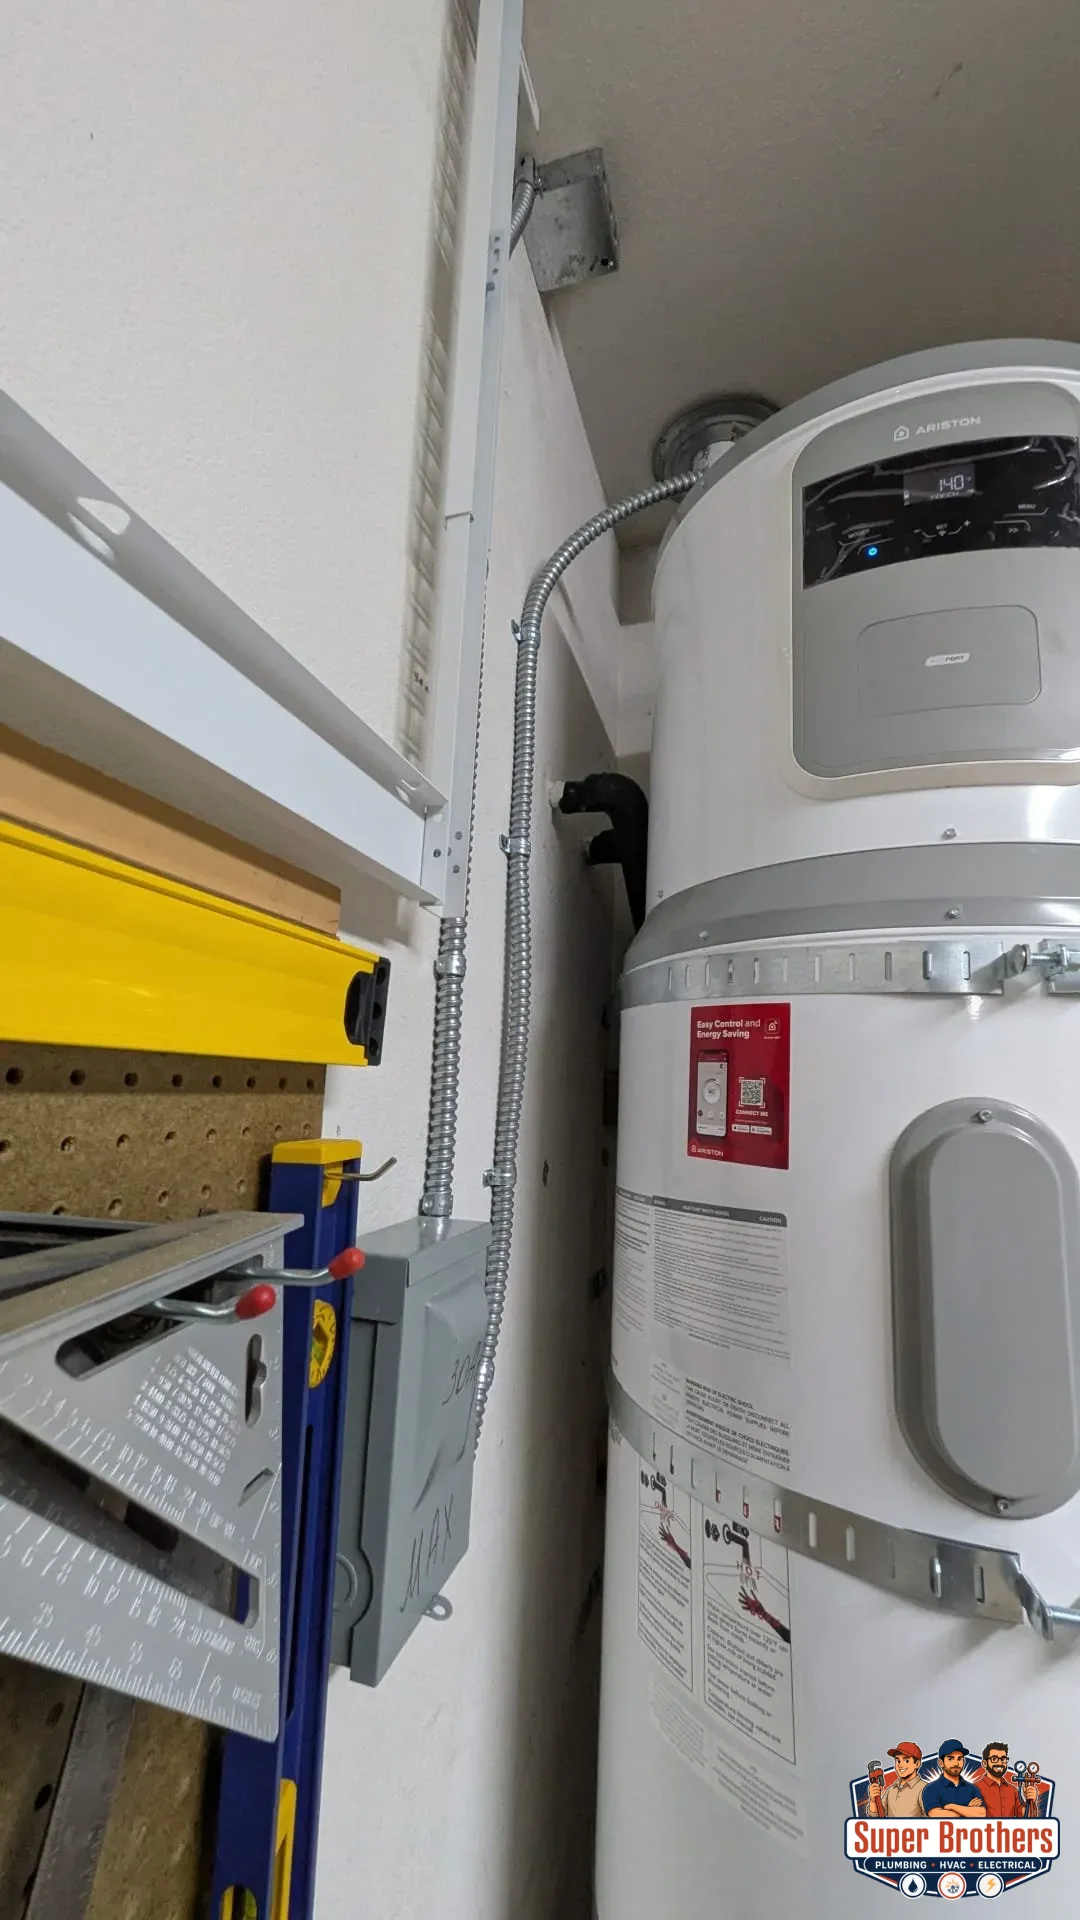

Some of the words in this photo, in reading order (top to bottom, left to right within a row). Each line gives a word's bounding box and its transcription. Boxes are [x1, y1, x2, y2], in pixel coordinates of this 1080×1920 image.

[915, 416, 981, 436] ARISTON
[940, 475, 964, 492] 140
[697, 1021, 714, 1030] Easy
[714, 1019, 743, 1028] Control
[744, 1018, 761, 1028] and
[696, 1030, 721, 1040] Energy
[722, 1029, 750, 1039] Saving
[697, 1147, 724, 1157] ARISTON
[400, 1494, 453, 1613] MAX
[736, 1560, 761, 1581] HOT
